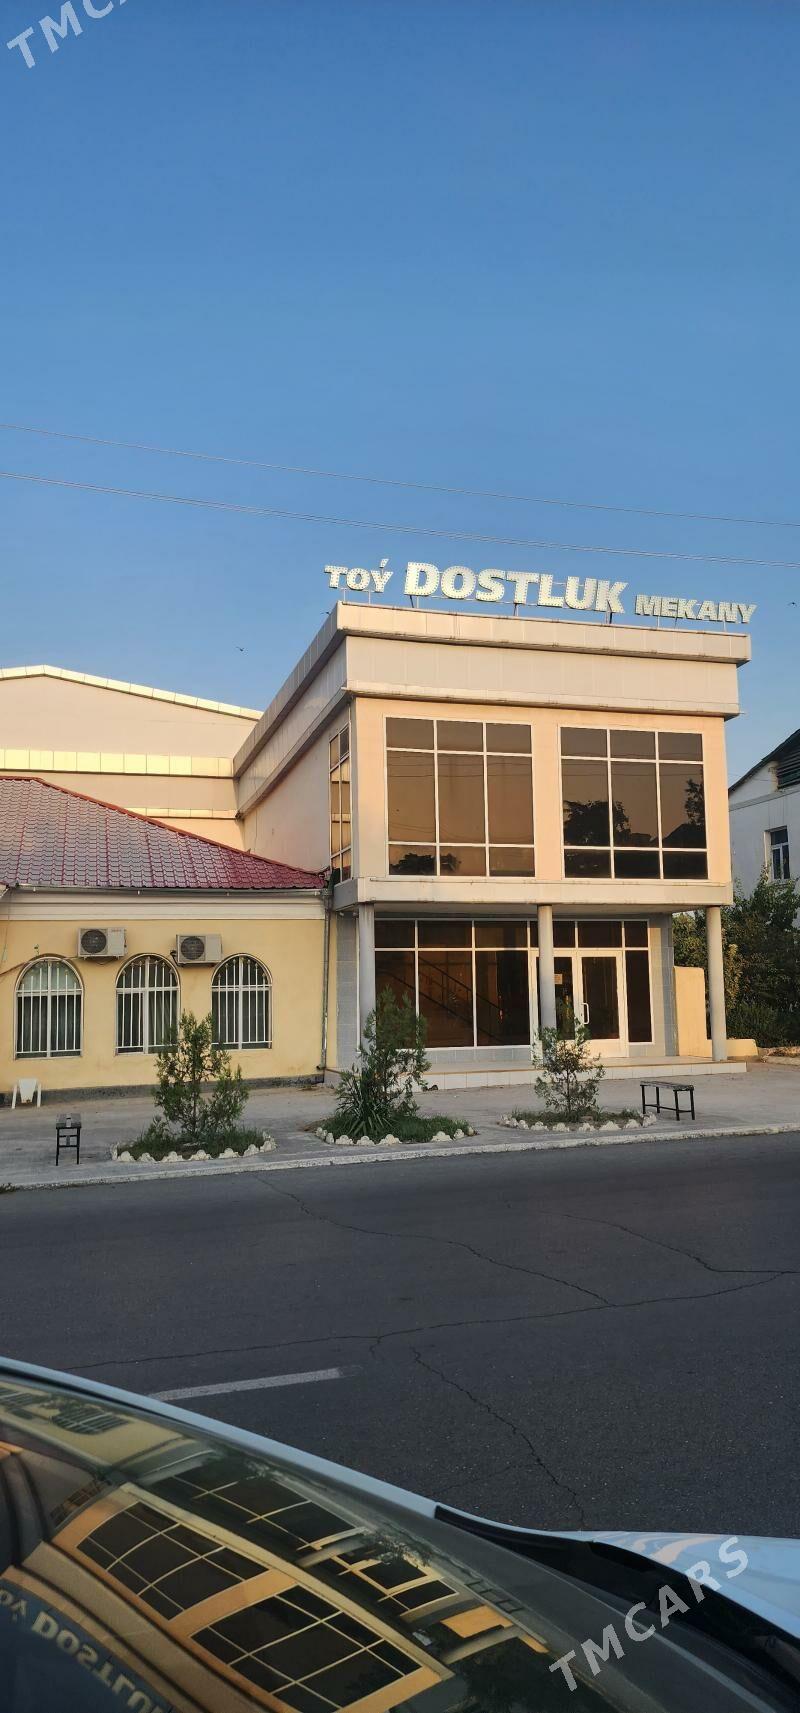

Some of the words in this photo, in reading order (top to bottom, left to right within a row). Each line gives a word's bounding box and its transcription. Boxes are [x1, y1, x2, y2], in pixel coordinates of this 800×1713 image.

[324, 558, 394, 593] TOÝ
[403, 561, 629, 614] DOSTLUK
[635, 594, 758, 624] MEKANY
